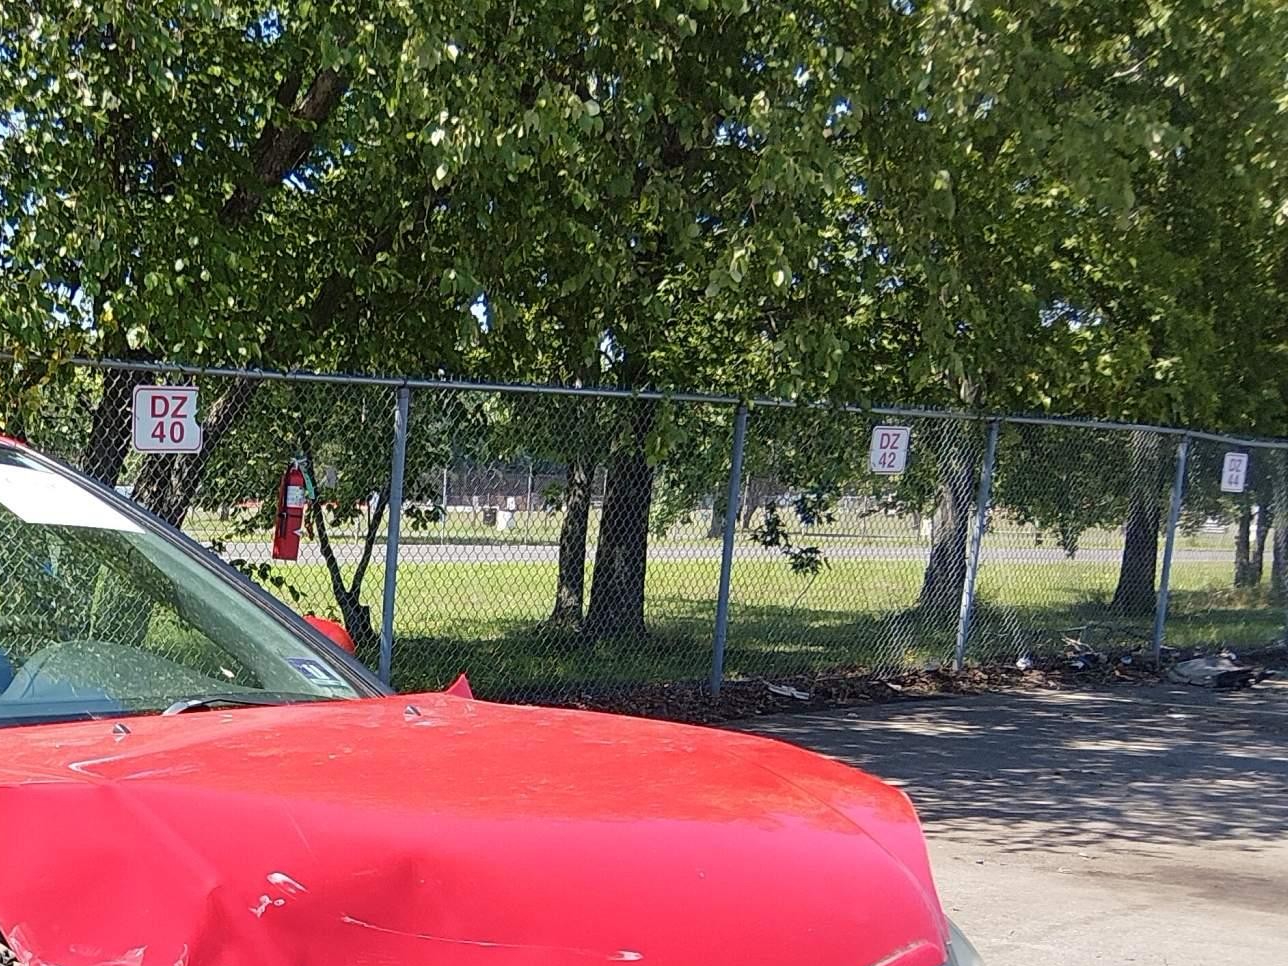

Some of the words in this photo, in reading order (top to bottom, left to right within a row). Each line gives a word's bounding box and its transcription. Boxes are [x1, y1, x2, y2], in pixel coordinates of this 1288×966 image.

[150, 395, 188, 418] DZ
[150, 421, 185, 443] 40
[879, 433, 901, 450] DZ
[878, 451, 897, 468] 42
